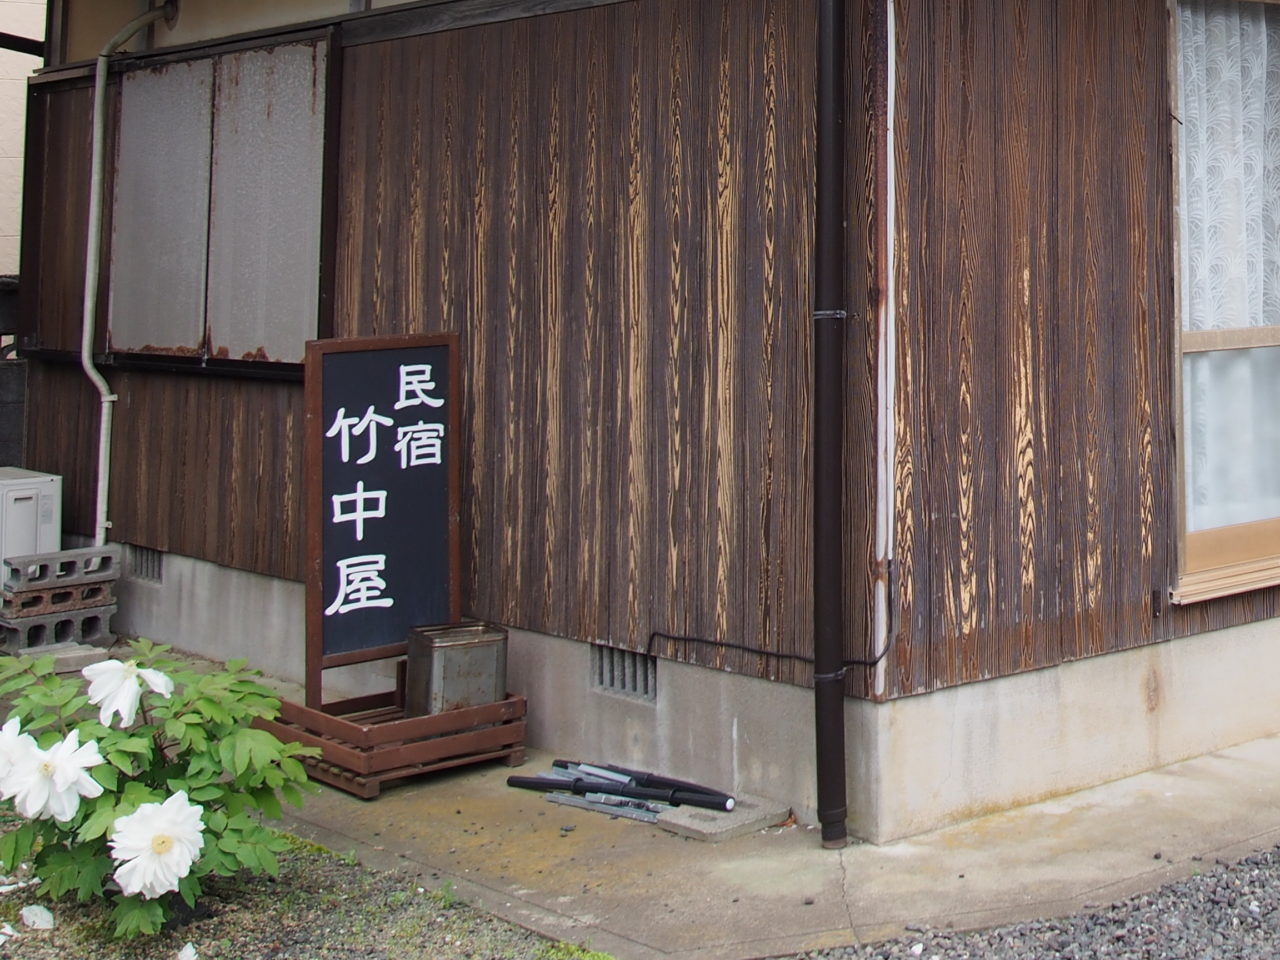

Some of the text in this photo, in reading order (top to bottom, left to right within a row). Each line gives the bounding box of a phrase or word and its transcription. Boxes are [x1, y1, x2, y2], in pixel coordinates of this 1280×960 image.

[393, 364, 445, 470] 民宿
[325, 404, 395, 616] 竹中屋
